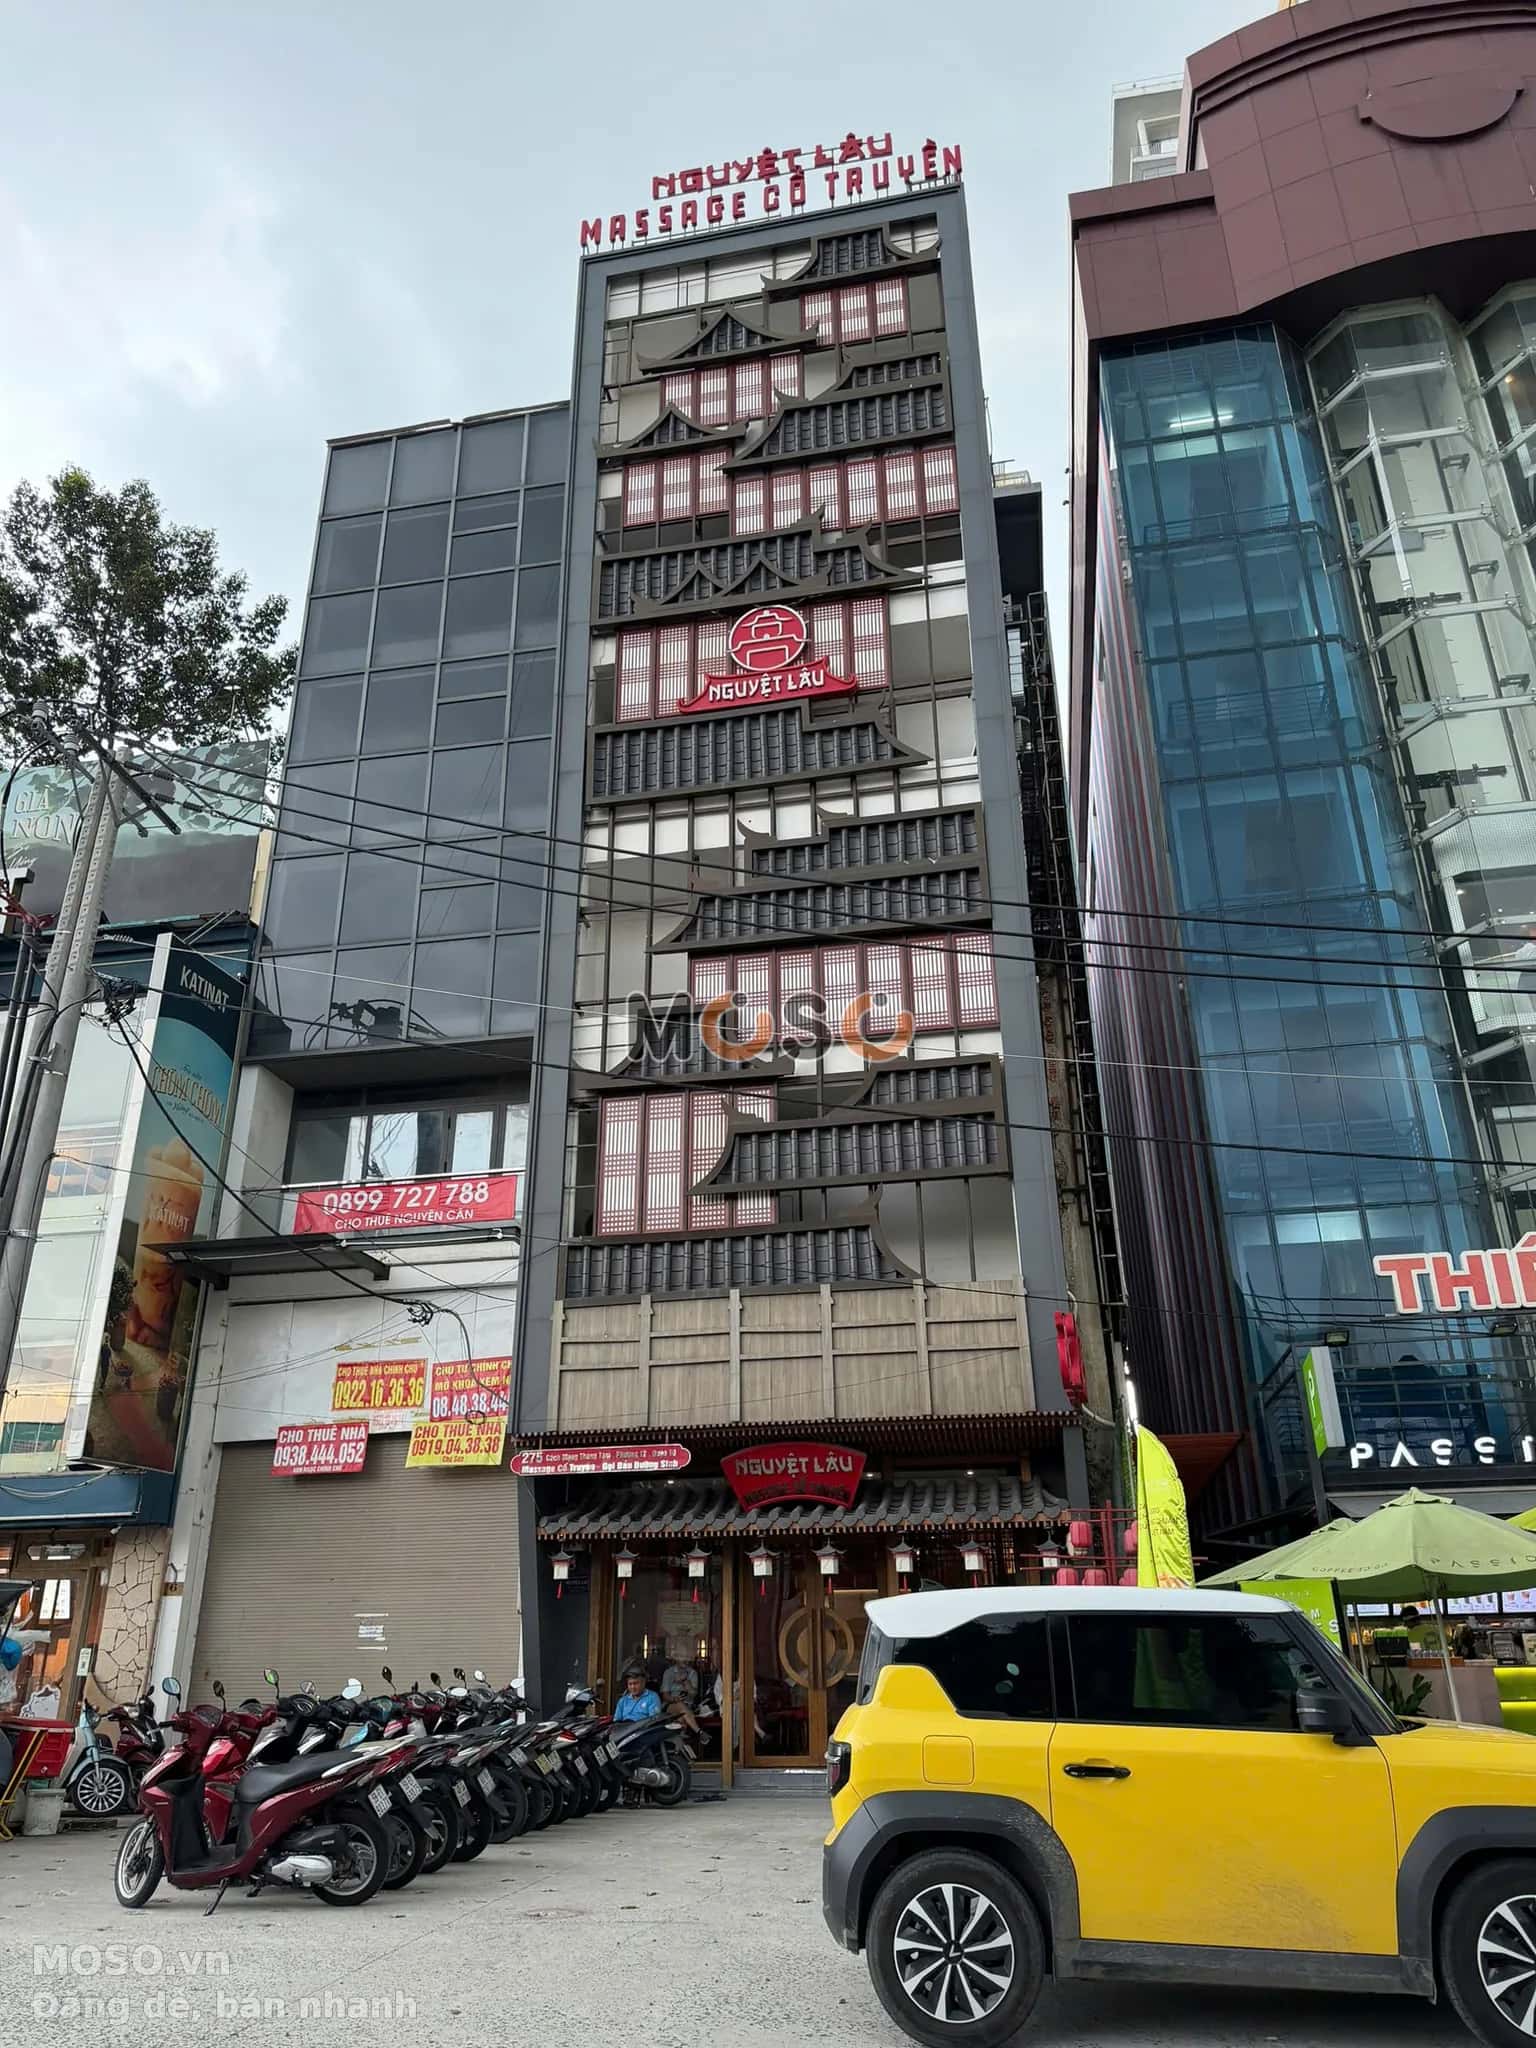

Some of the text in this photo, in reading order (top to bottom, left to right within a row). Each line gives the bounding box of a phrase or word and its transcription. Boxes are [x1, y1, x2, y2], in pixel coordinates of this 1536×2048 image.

[580, 191, 747, 248] MASSAGE
[708, 673, 783, 702] NGUYỆT
[180, 965, 230, 1014] KATINAT
[323, 1181, 490, 1216] 0899 727 788
[335, 1217, 362, 1230] CHO
[365, 1213, 391, 1227] THUÊ
[334, 1377, 424, 1409] 0922.16.36.36
[279, 1430, 304, 1444] CHO
[307, 1425, 338, 1442] THUÊ
[414, 1424, 439, 1439] CHO
[273, 1441, 366, 1467] 0938.444.052
[521, 1452, 543, 1464] 275
[735, 1452, 809, 1479] NGUYỆT
